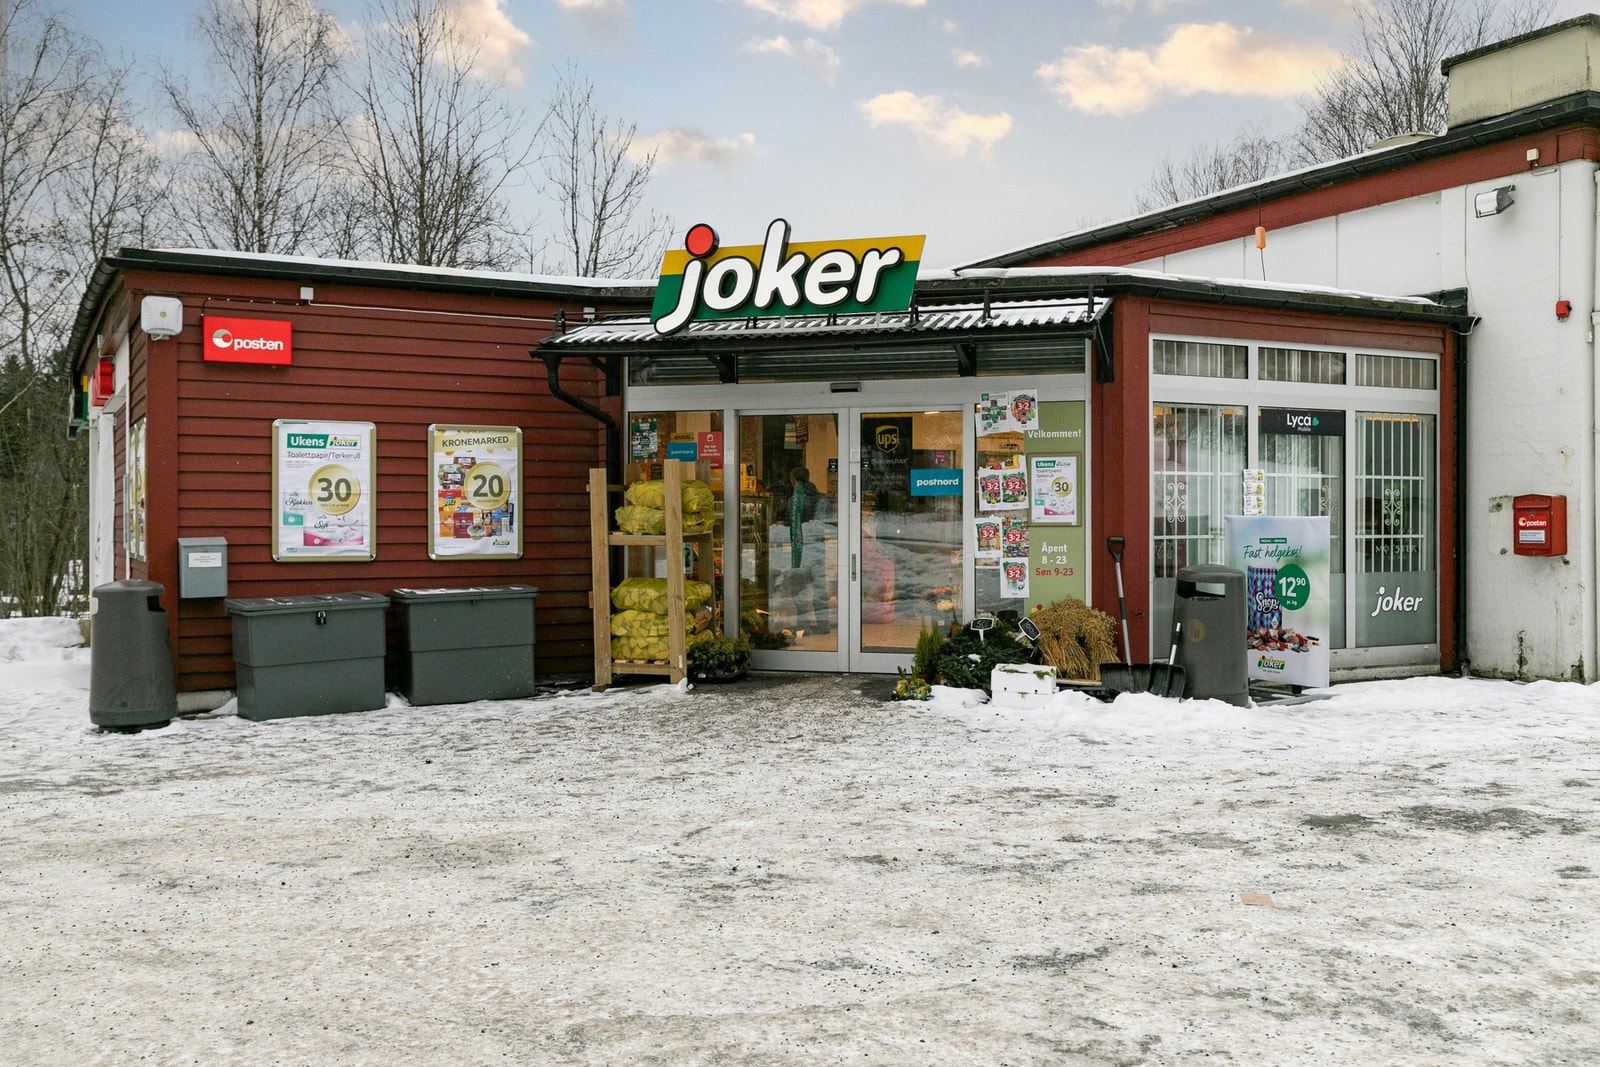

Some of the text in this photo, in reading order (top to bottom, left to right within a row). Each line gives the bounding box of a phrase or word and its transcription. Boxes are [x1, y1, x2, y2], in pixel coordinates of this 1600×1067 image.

[654, 219, 905, 335] joker
[233, 338, 284, 351] posten
[1286, 413, 1312, 428] Lyca
[878, 432, 897, 448] ups
[1027, 429, 1082, 439] Velkommen!
[290, 435, 325, 447] Ukens
[441, 435, 510, 448] KRONEMARKED
[286, 450, 361, 461] Toalettpapir/Tørkerull
[317, 477, 352, 502] 30
[473, 474, 504, 498] 20
[917, 478, 960, 489] postnord
[1054, 482, 1069, 492] 30
[1041, 542, 1067, 554] Åpent
[1243, 545, 1303, 563] Fast helgekos!
[1041, 555, 1048, 564] 8
[1056, 555, 1067, 565] 23
[1035, 567, 1075, 576] Søn 9-23
[1371, 586, 1424, 617] joker
[1257, 655, 1286, 670] joker
